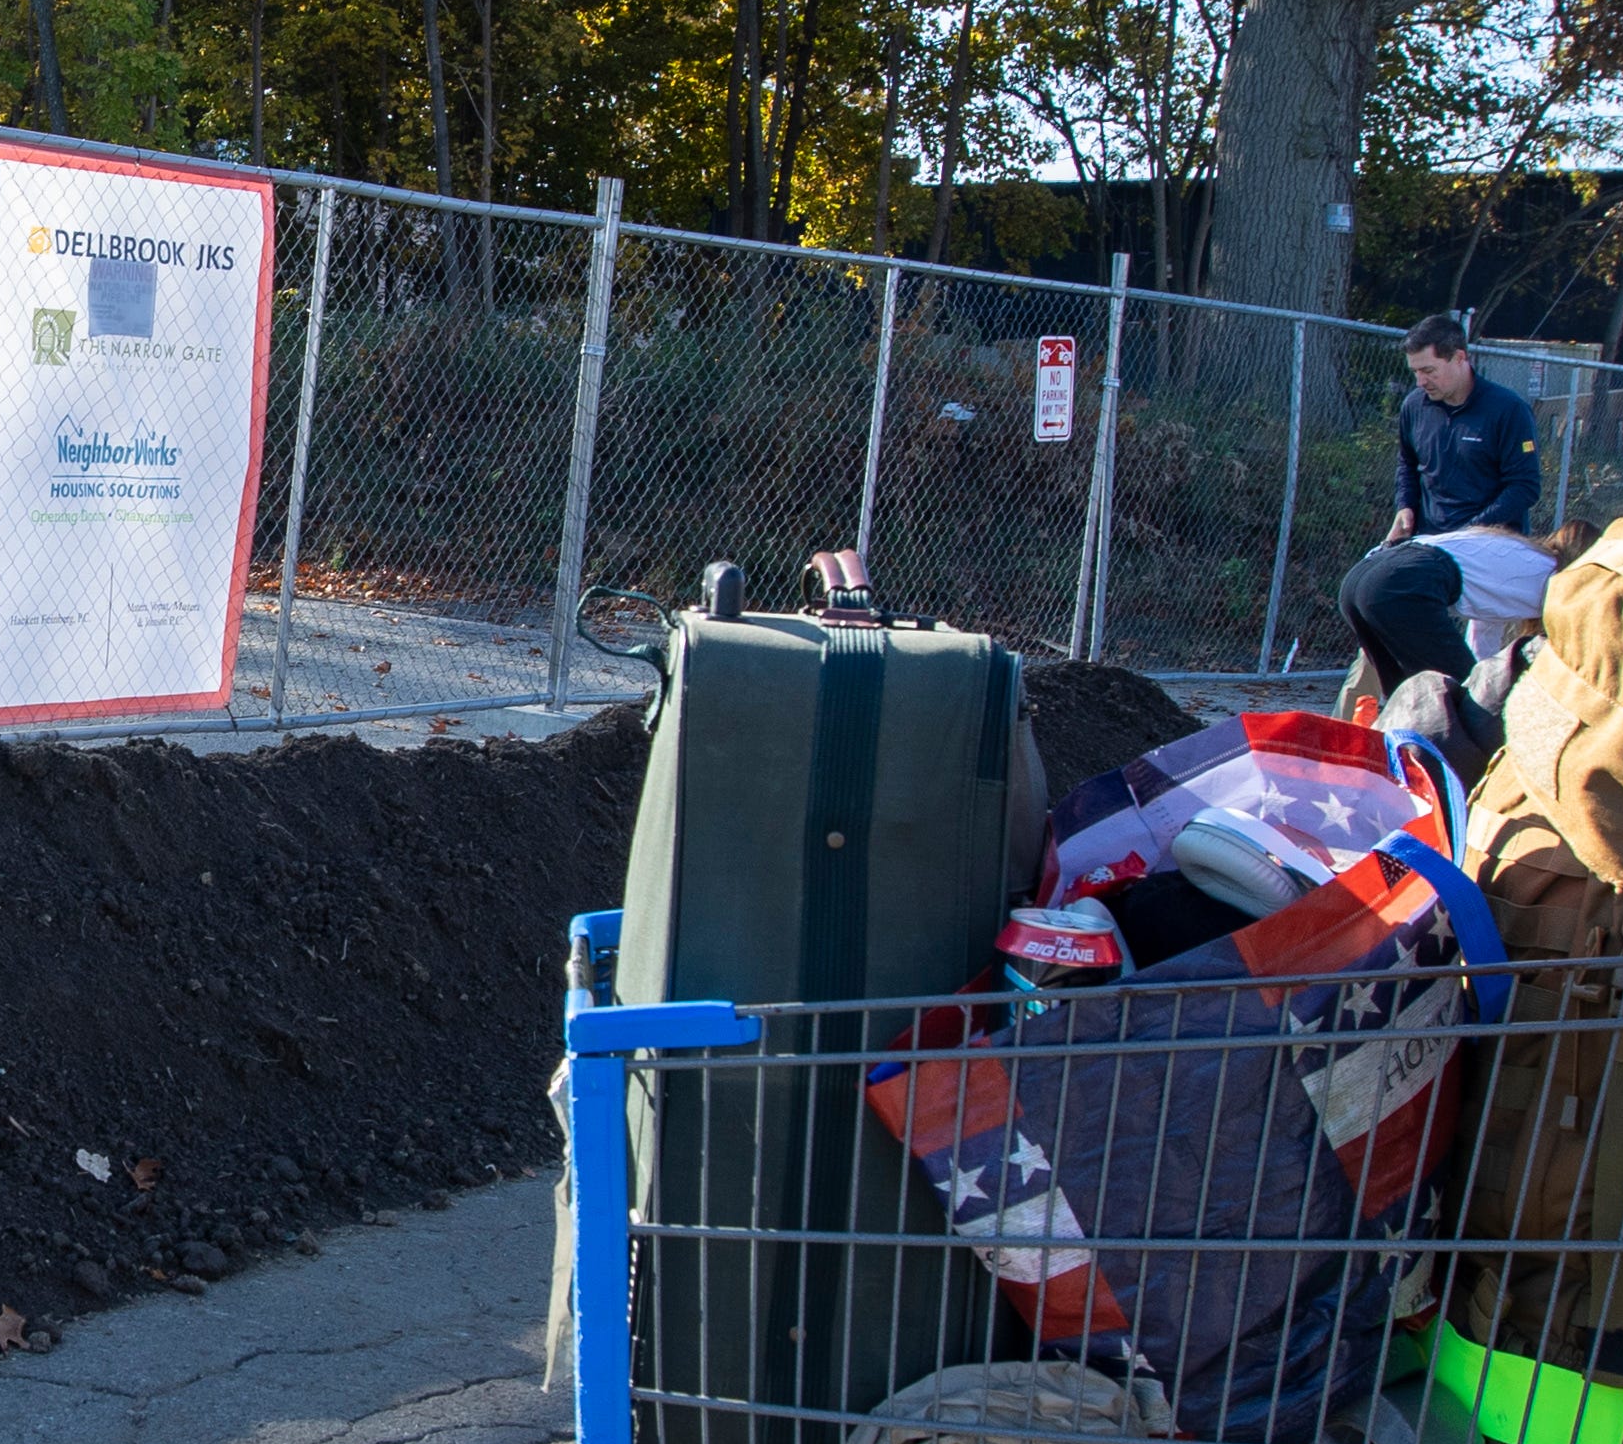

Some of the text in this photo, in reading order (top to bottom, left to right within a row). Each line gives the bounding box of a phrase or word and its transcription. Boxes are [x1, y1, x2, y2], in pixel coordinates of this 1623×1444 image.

[55, 229, 234, 271] DELLBROOK JKS
[111, 341, 176, 358] NARROW
[183, 346, 222, 363] GATE
[1050, 370, 1062, 386] NO
[1042, 390, 1068, 400] PARKING
[51, 482, 180, 499] HOUSING SOLUTIONS
[1054, 936, 1073, 947] THE
[1023, 941, 1095, 962] BIG ONE
